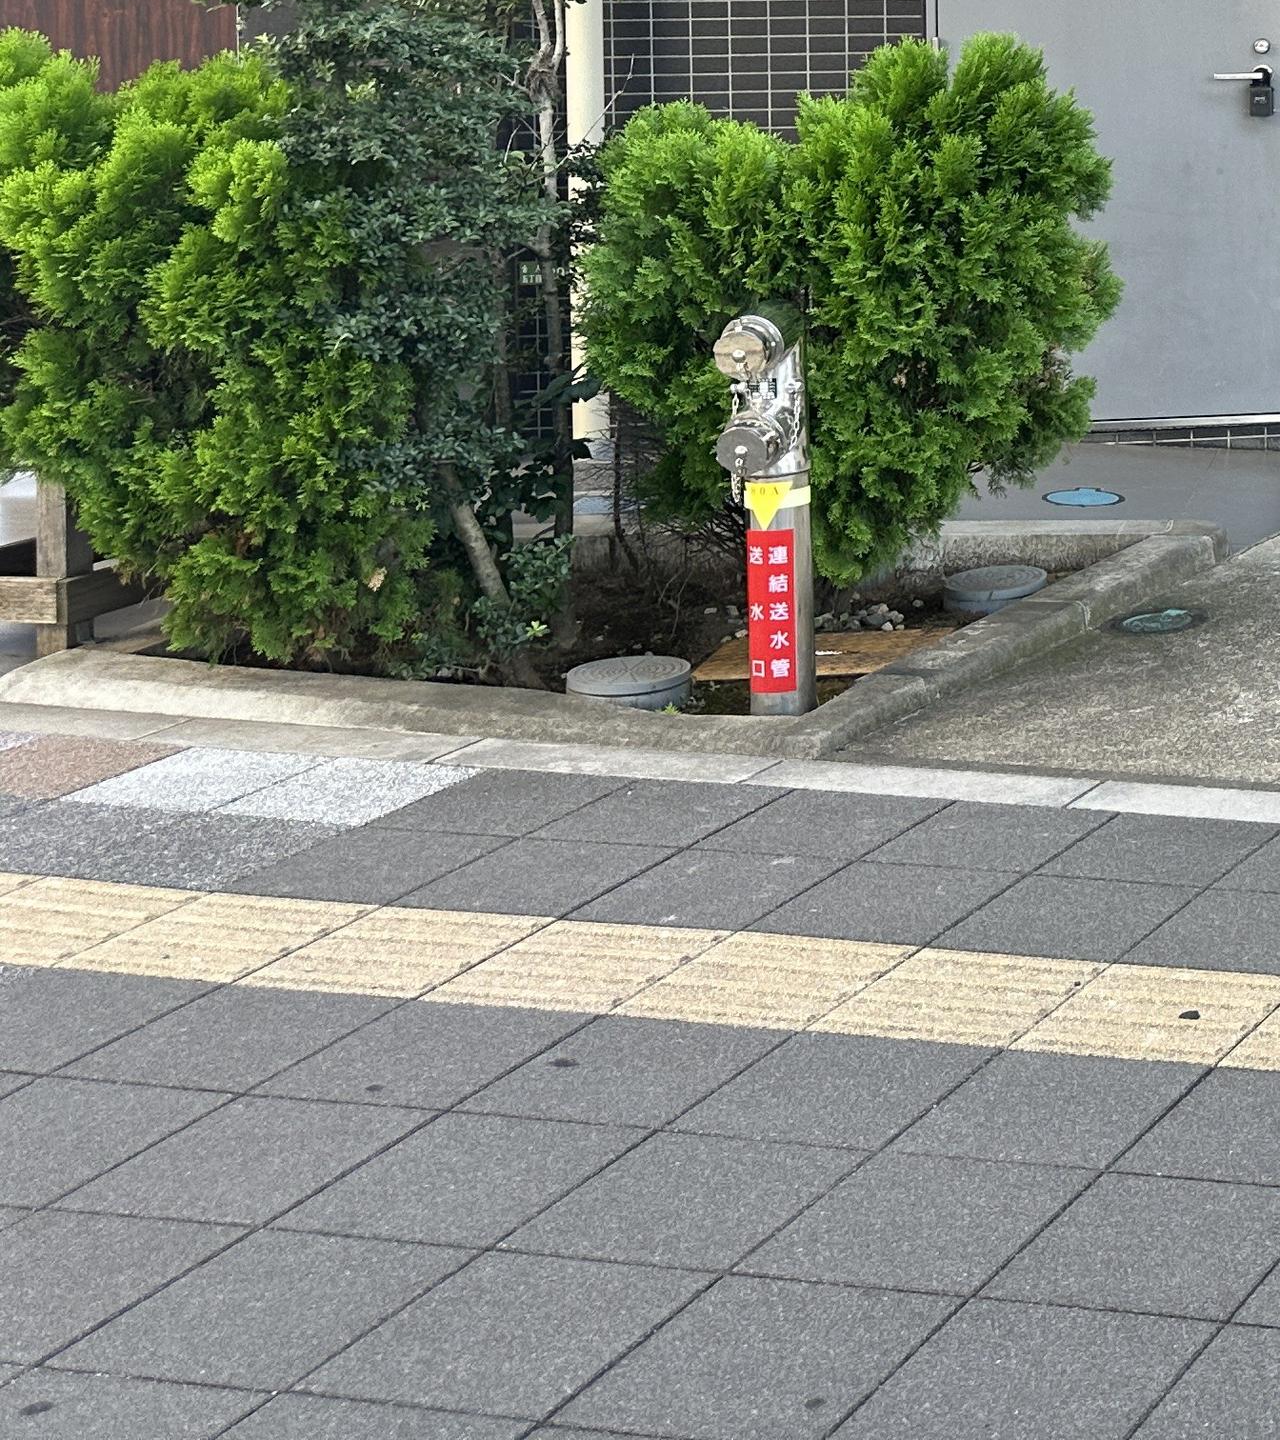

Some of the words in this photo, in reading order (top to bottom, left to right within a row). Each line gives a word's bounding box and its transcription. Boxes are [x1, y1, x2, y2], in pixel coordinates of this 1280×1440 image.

[749, 545, 764, 678] 送水口
[768, 545, 792, 679] 連結送水管
